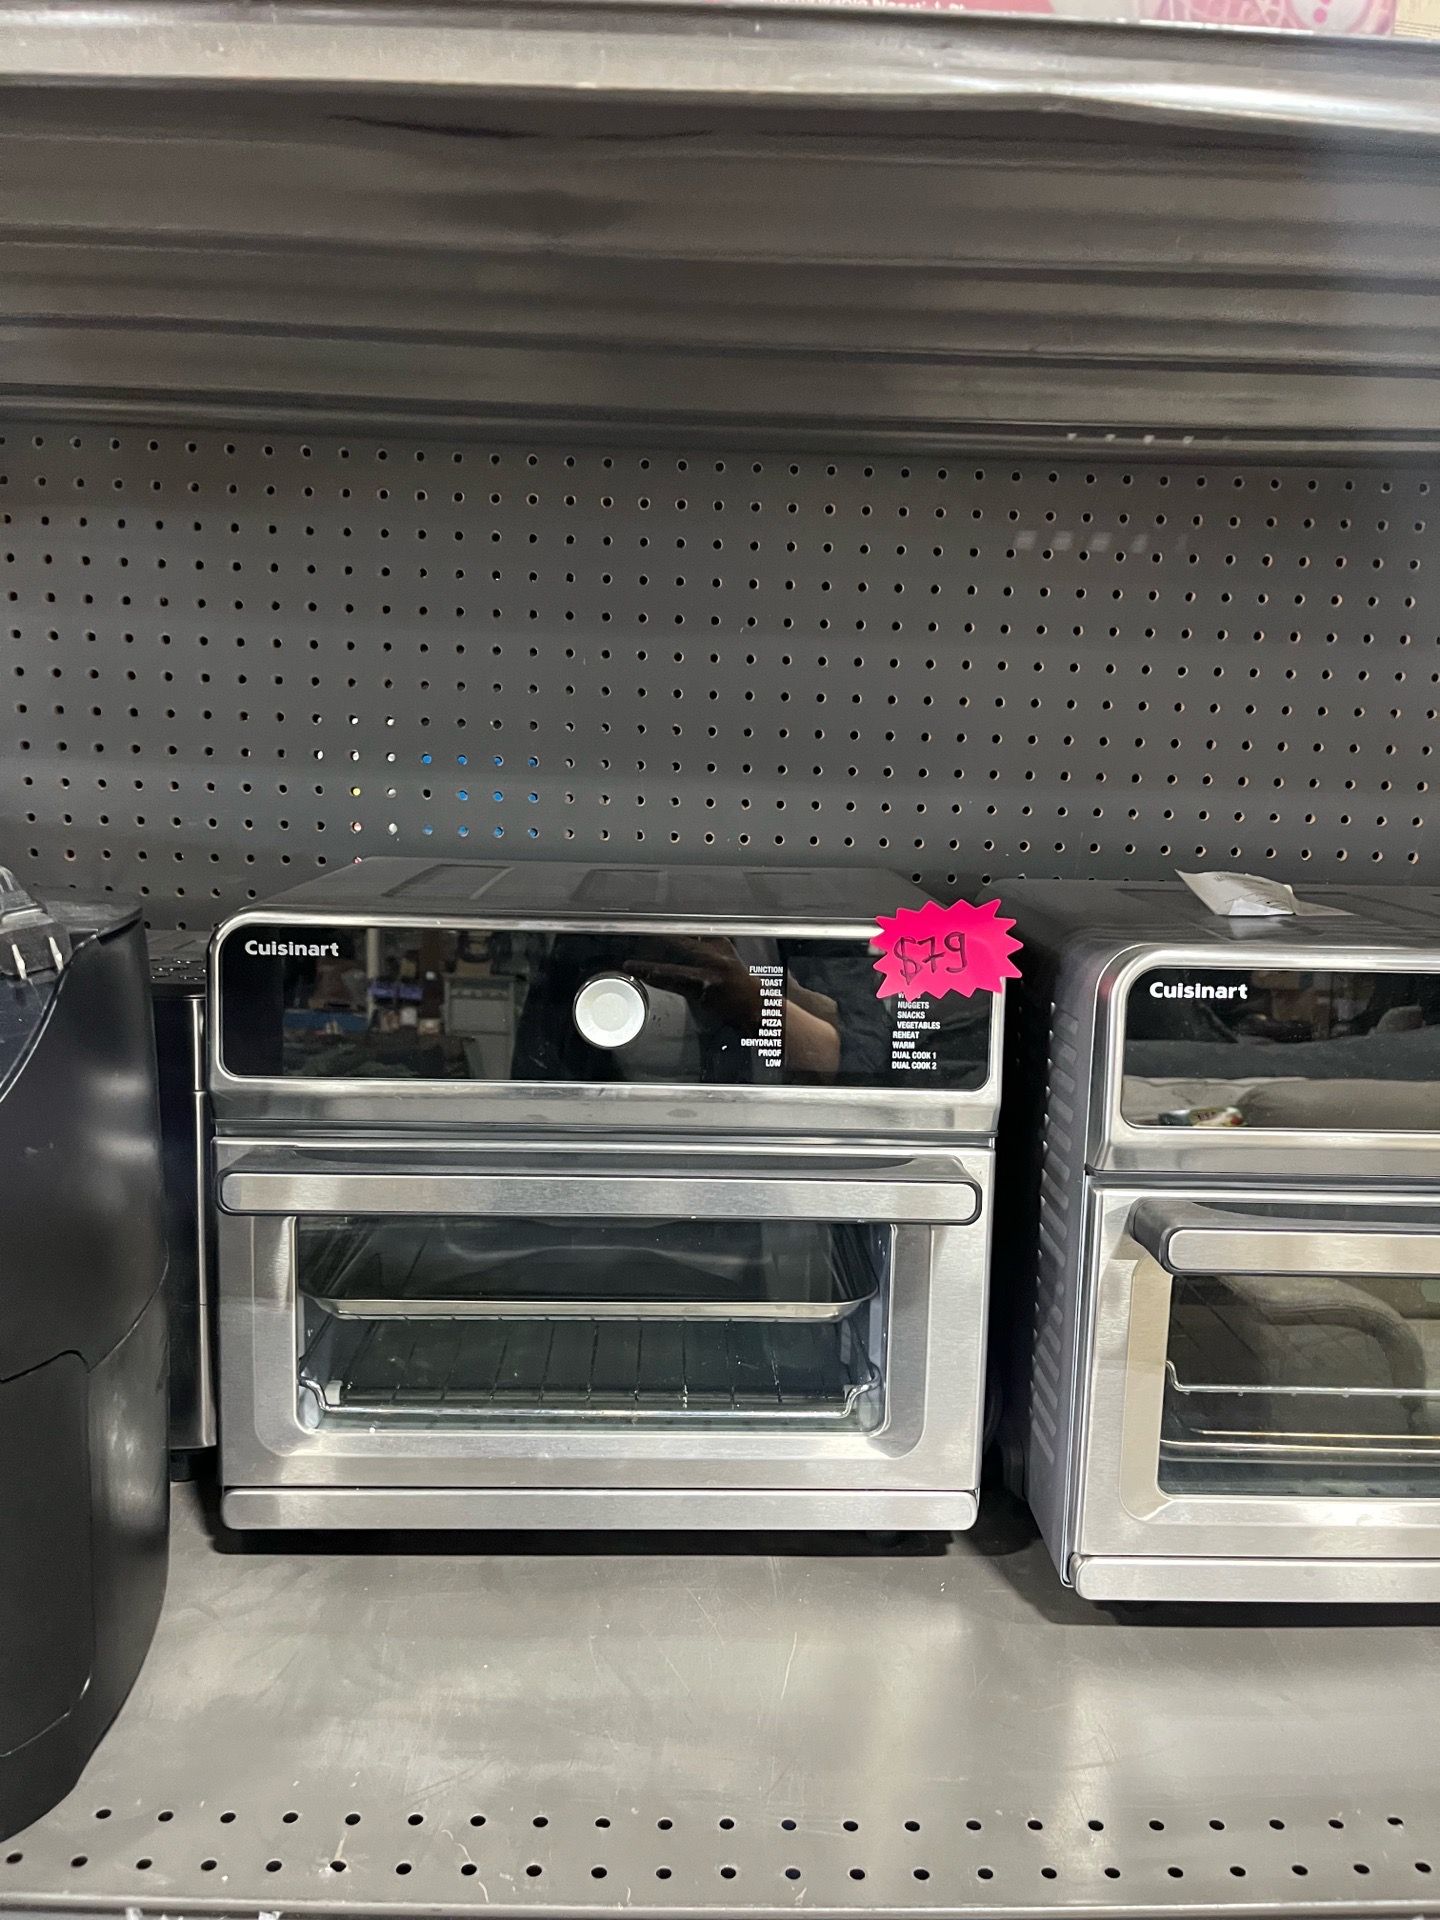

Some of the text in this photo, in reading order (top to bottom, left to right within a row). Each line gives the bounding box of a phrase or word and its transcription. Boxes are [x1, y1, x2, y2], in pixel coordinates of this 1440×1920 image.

[244, 939, 339, 957] Cuisinart
[893, 931, 968, 986] $79
[749, 965, 784, 974] FUNCTION
[760, 979, 783, 987] TOAST
[760, 989, 783, 997] BAGEL
[1149, 981, 1248, 1000] Cuisinart
[764, 999, 783, 1007] BAKE
[897, 1001, 930, 1010] NUGGETS
[761, 1009, 783, 1017] BROIL
[897, 1011, 926, 1019] SNACKS
[761, 1019, 783, 1027] PIZZA
[896, 1021, 941, 1030] VEGETABLES
[758, 1029, 782, 1037] ROAST
[892, 1031, 920, 1039] REHEAT
[740, 1039, 782, 1047] DEHYDRATE
[892, 1041, 915, 1049] WARM
[758, 1049, 782, 1057] PROOF
[892, 1051, 937, 1060] DUAL COOK 1
[765, 1059, 782, 1067] LOW
[891, 1061, 937, 1070] DUAL COOK 2
